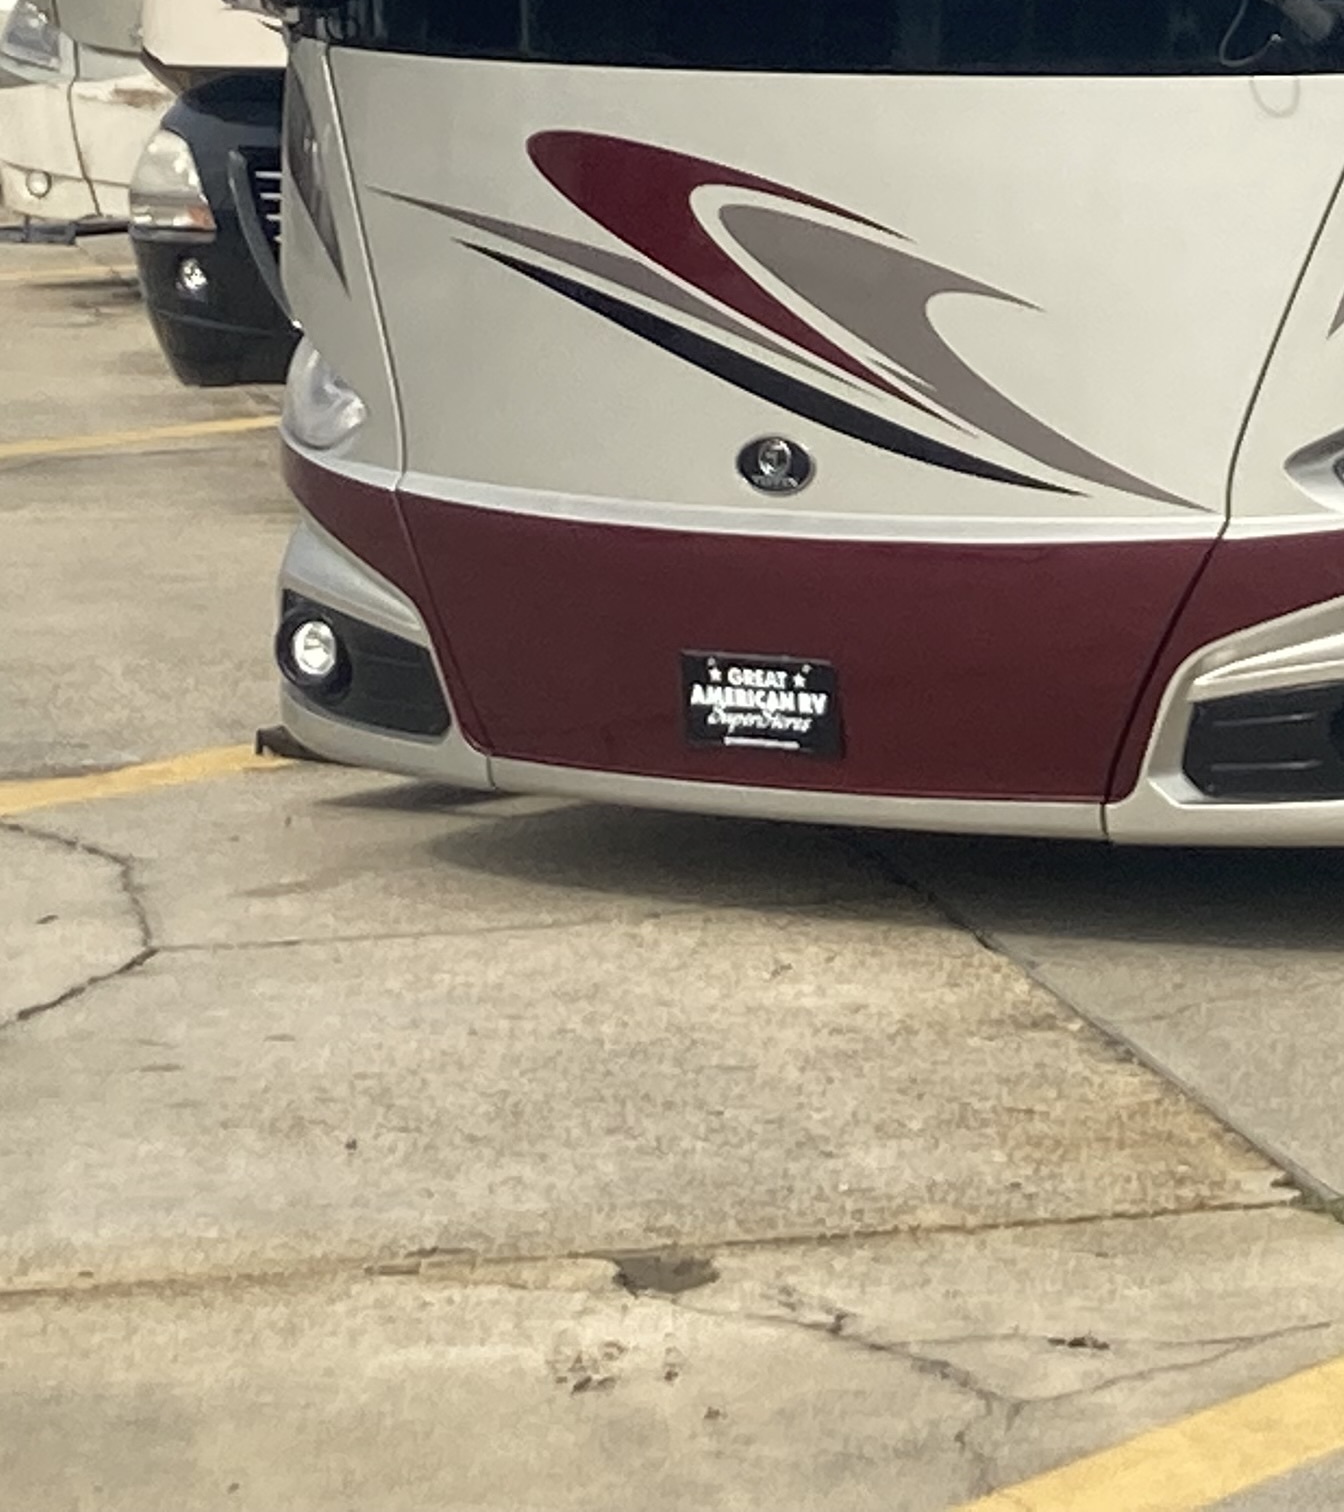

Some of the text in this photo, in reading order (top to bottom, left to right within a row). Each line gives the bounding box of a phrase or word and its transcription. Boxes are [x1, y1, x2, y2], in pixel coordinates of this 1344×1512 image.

[727, 666, 788, 689] GREAT
[691, 683, 828, 715] AMERICAN RV
